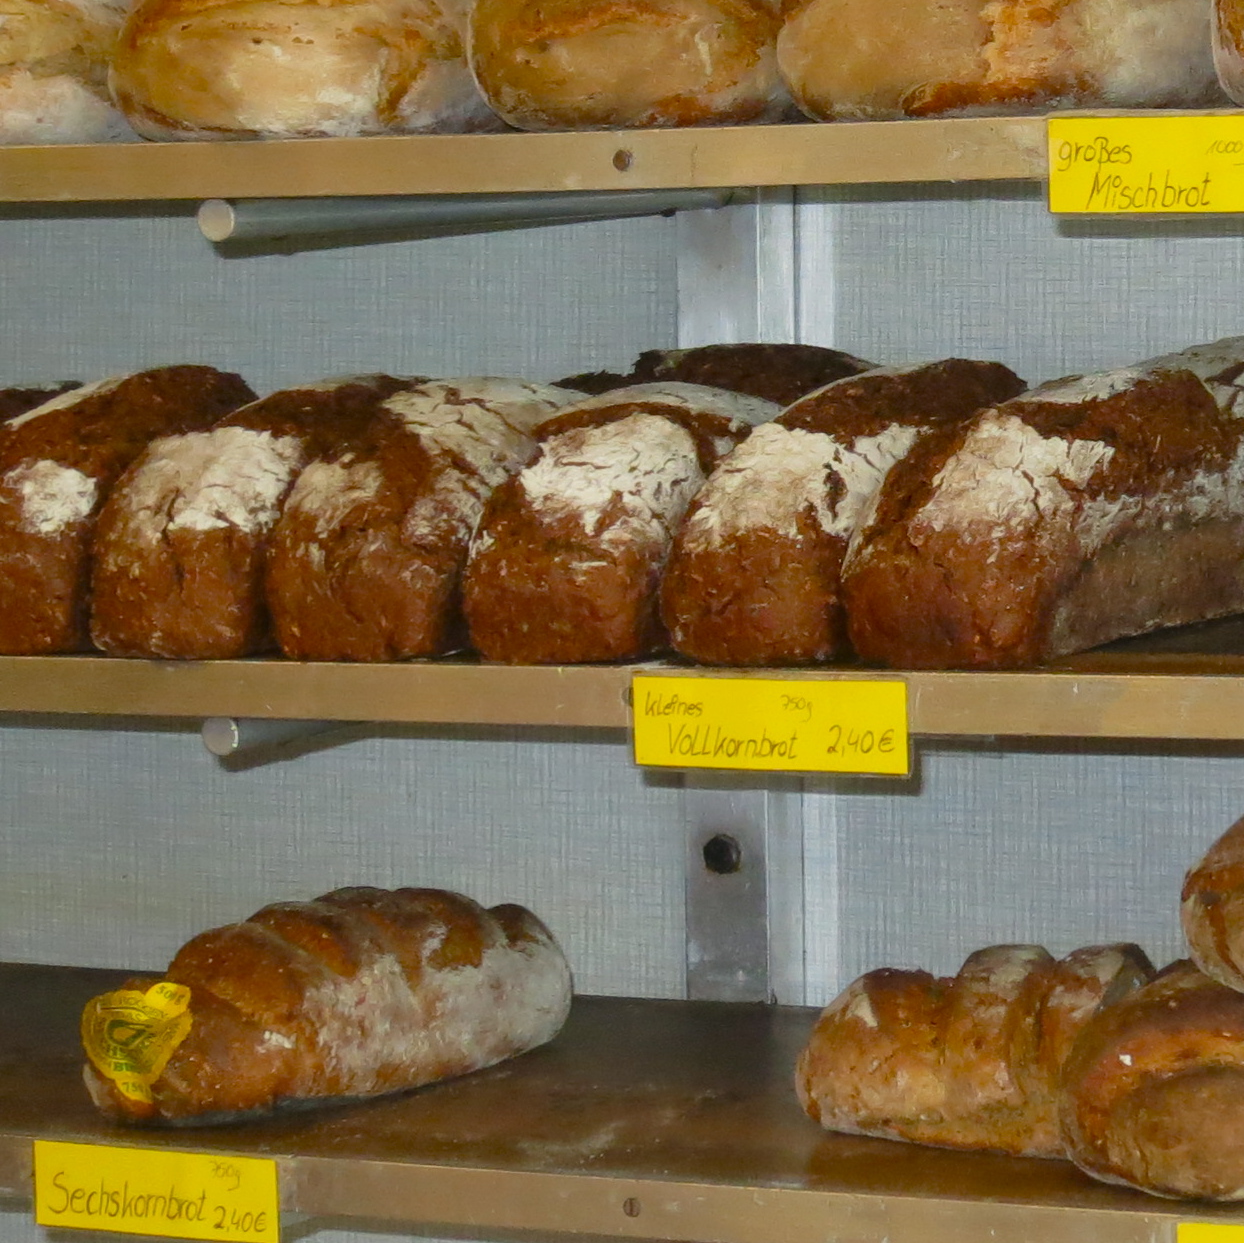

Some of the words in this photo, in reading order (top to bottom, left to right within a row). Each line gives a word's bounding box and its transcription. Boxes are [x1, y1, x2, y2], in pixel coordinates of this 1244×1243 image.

[1085, 169, 1211, 210] Mischbrot
[826, 724, 895, 757] 2,40€
[48, 1171, 207, 1221] Sechskornbrot
[213, 1205, 268, 1233] 2,40€
